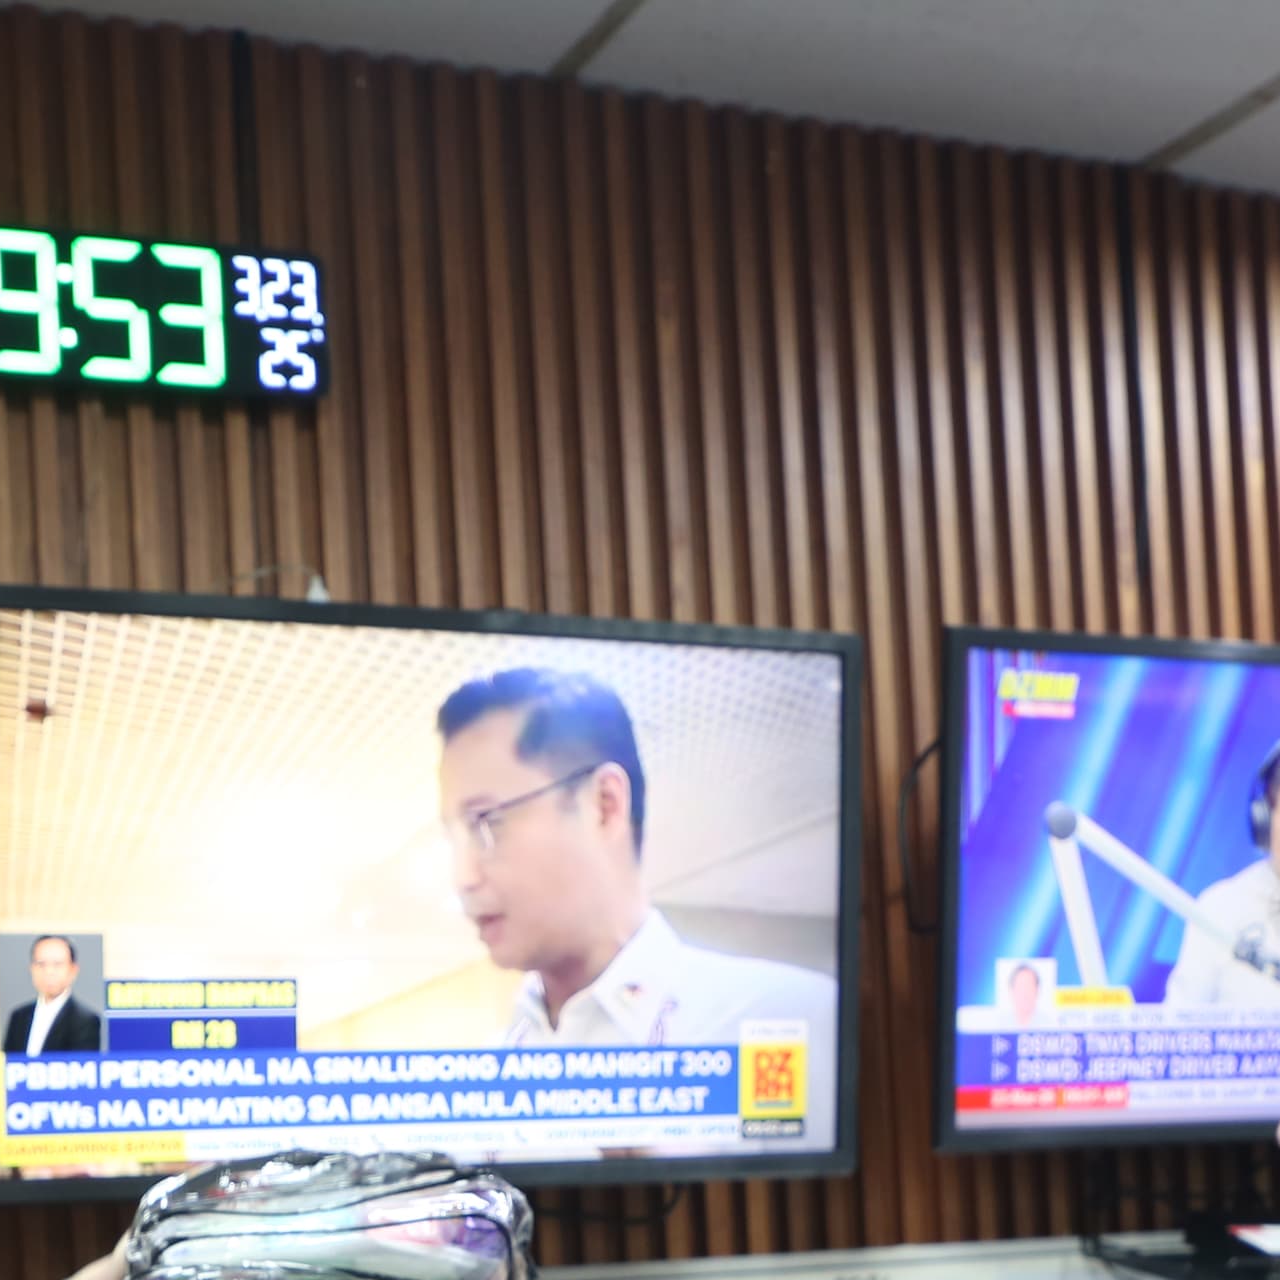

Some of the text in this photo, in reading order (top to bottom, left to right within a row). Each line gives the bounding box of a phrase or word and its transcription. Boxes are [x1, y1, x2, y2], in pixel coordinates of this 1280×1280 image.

[100, 1057, 264, 1088] PERSONAL
[267, 1055, 311, 1084] NA
[501, 1051, 563, 1082] ANG
[680, 1049, 732, 1077] 300
[7, 1085, 709, 1130] OFWs NA DUMATING SA BANSA MULA MIDDLE EAST
